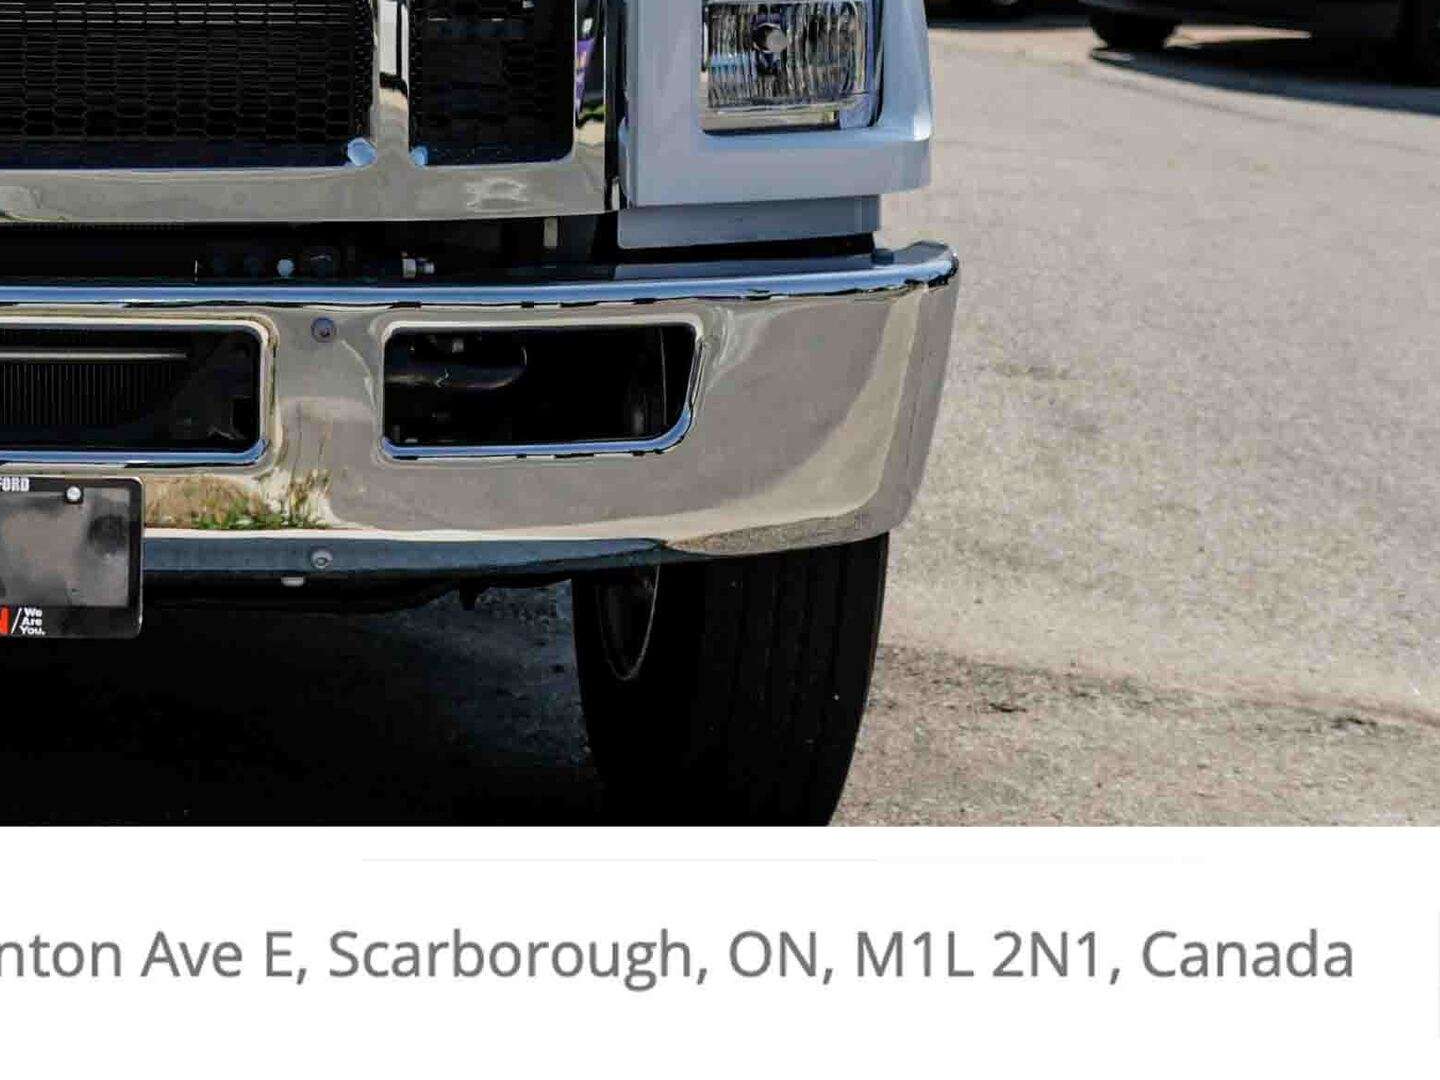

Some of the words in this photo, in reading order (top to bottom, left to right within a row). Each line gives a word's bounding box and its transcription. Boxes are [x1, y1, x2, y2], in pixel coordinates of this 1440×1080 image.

[23, 607, 43, 618] We
[21, 617, 43, 627] Are
[19, 625, 46, 635] You.
